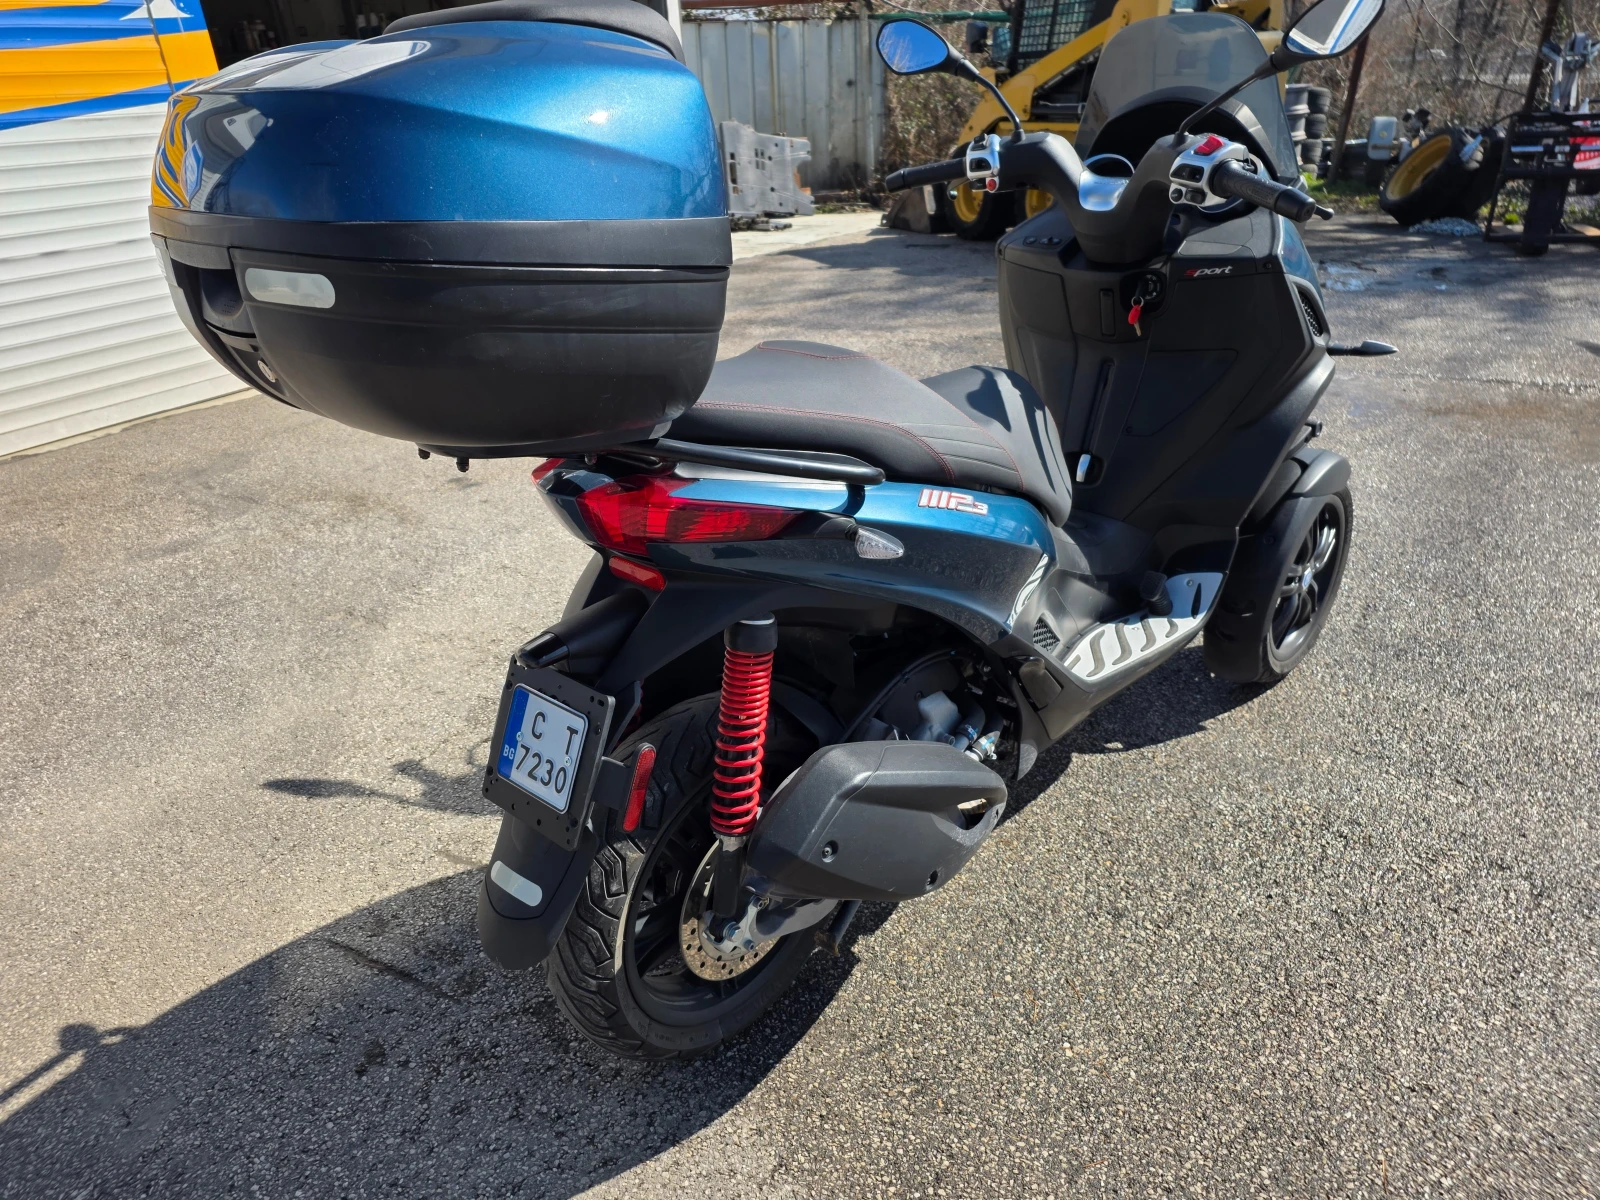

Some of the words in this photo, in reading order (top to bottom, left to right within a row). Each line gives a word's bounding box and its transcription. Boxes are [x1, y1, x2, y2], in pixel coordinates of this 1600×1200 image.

[918, 488, 988, 516] MP3
[503, 744, 515, 760] BG
[515, 743, 567, 794] 7230
